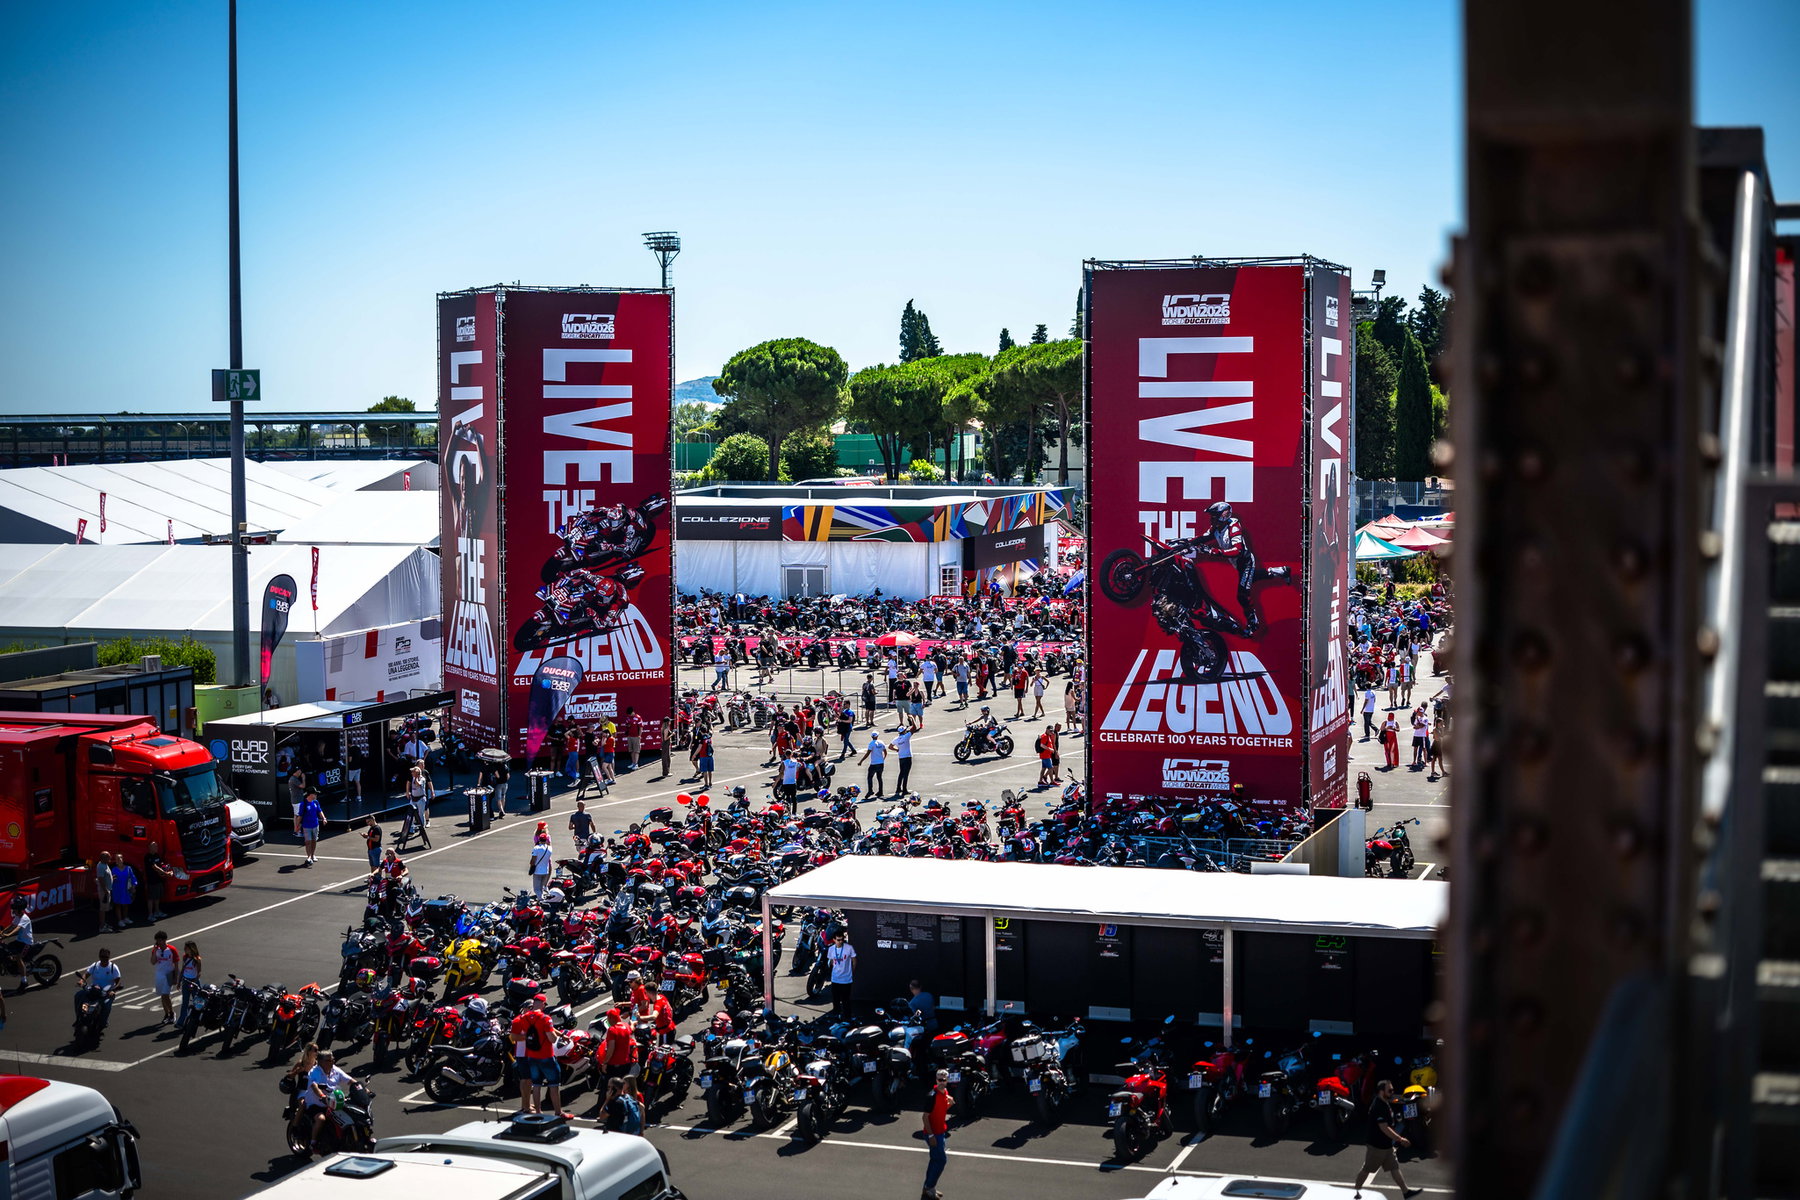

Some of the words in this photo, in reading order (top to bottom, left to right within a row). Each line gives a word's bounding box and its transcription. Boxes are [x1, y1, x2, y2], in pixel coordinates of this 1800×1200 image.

[1162, 304, 1231, 319] WDW2026
[562, 322, 615, 333] WDW2026
[543, 348, 633, 486] LIVE
[1139, 336, 1253, 504] LIVE
[1321, 336, 1342, 500] LIVE
[1139, 511, 1197, 558] THE
[458, 537, 485, 604] THE
[269, 585, 293, 598] DUCATI
[1330, 579, 1340, 639] THE
[445, 600, 498, 676] LEGEND
[542, 666, 576, 678] DUCATI
[585, 673, 615, 682] YEARS
[618, 670, 664, 679] TOGETHER
[1100, 648, 1293, 736] LEGEND
[565, 700, 618, 715] WDW2026
[231, 740, 268, 752] QUAD
[1099, 732, 1165, 744] CELEBRATE
[1167, 734, 1186, 744] 100
[1189, 735, 1227, 746] YEARS
[1231, 736, 1293, 748] TOGETHER
[231, 750, 269, 763] LOCK
[1162, 769, 1230, 783] WDW2026
[24, 883, 73, 913] UCATI
